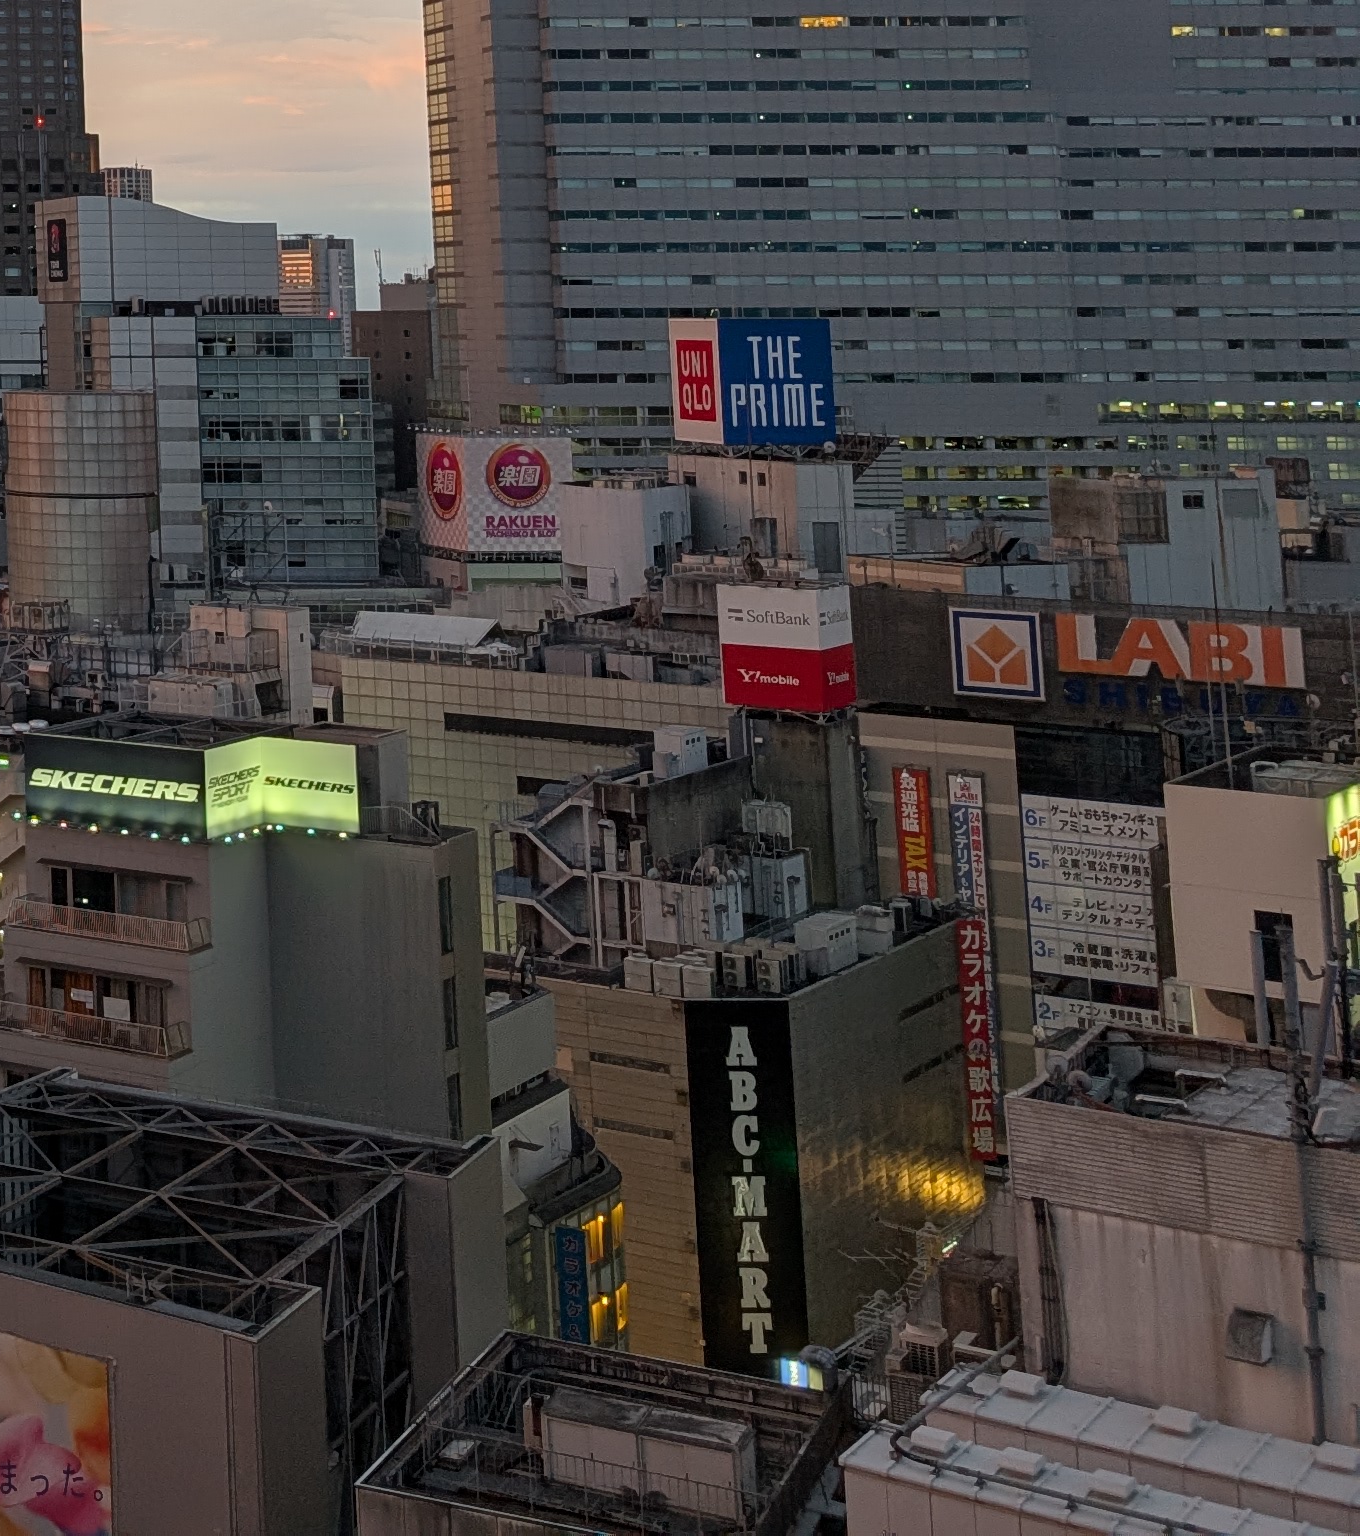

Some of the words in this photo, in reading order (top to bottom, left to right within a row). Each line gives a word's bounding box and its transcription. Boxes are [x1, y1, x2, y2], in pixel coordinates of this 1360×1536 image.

[681, 350, 707, 378] UNI
[746, 336, 803, 379] THE
[682, 383, 711, 415] QLO
[730, 383, 826, 427] PRIME
[498, 464, 542, 487] 楽園
[485, 515, 556, 528] RAKUEN
[746, 609, 811, 626] SoftBank
[1055, 613, 1305, 689] LABI
[737, 668, 800, 686] Y!mobile
[1063, 677, 1299, 714] SHIBUYA
[29, 767, 201, 803] SKECHERS
[208, 765, 261, 789] SKECHERS
[263, 776, 356, 794] SKECHERS
[211, 779, 254, 803] SPORT
[953, 791, 978, 801] LABI
[1025, 809, 1046, 826] 6F
[1028, 852, 1049, 869] 5F
[1031, 895, 1052, 913] 4F
[1034, 940, 1055, 957] 3F
[1038, 1002, 1060, 1020] 2F
[726, 1026, 773, 1353] ABC-MART
